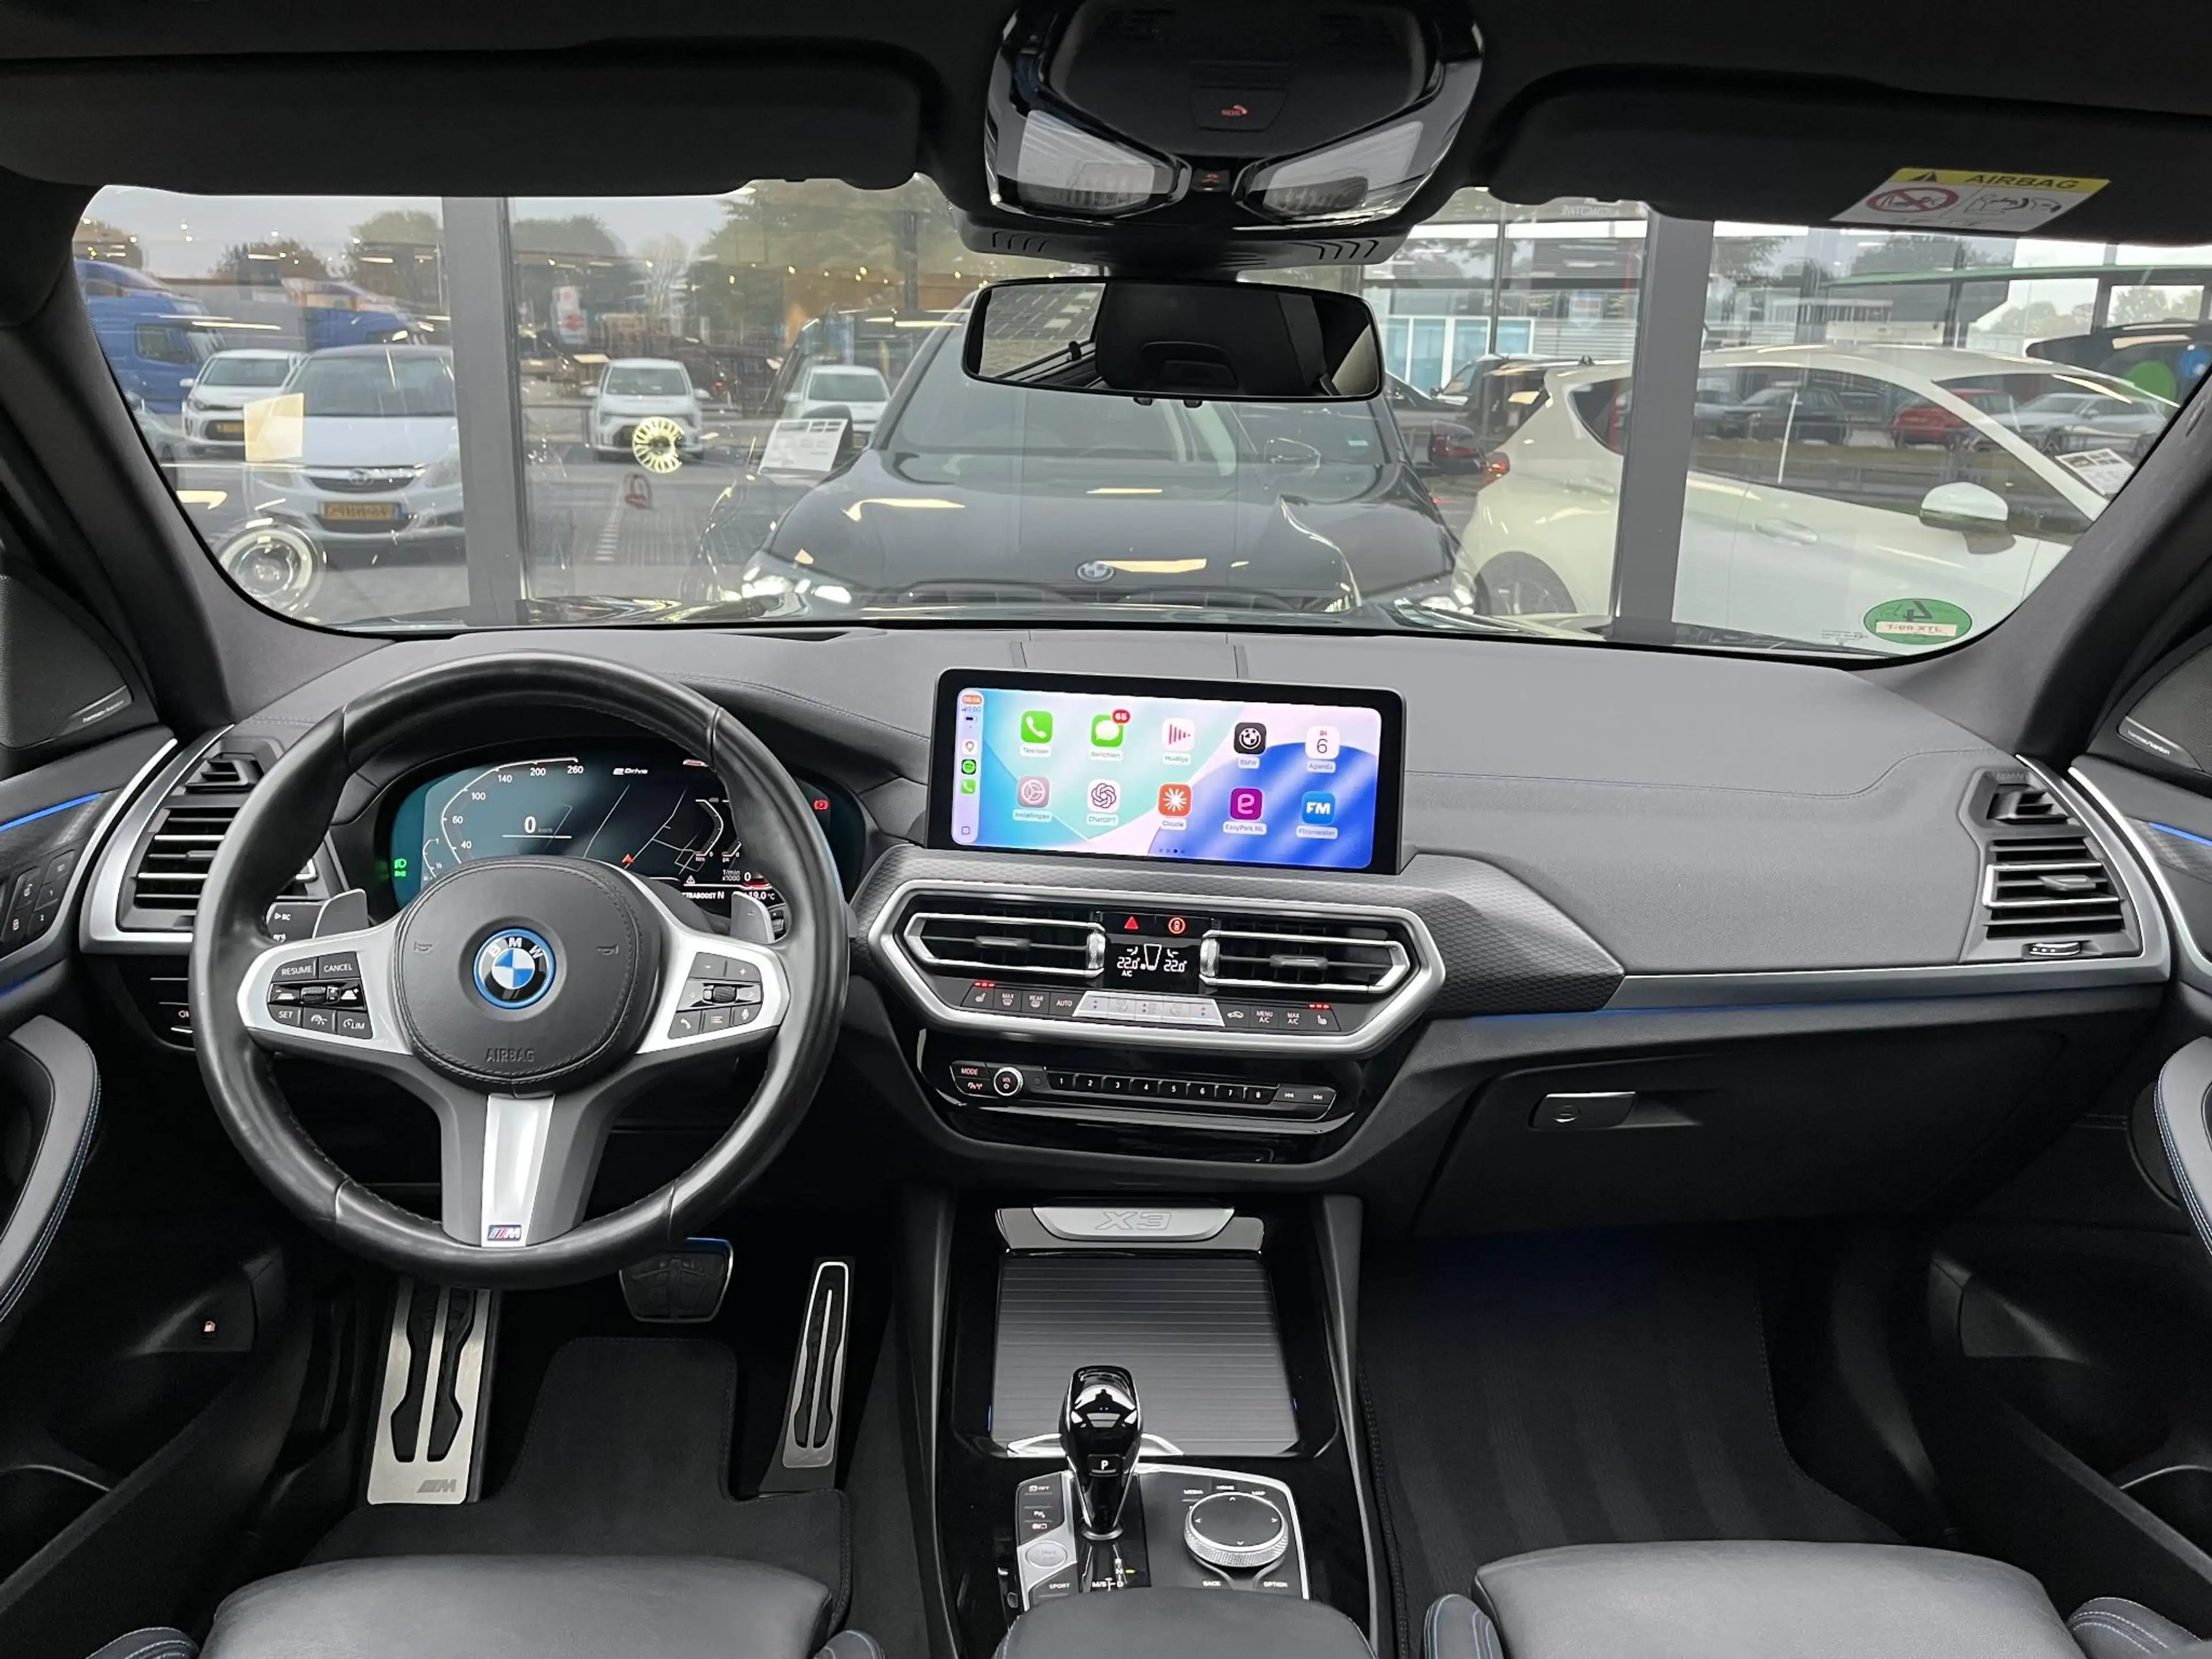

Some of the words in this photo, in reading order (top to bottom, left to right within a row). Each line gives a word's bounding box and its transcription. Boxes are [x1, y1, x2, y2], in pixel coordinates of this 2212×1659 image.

[1964, 175, 2080, 189] AIRBAG
[1316, 738, 1328, 754] 6
[1240, 759, 1257, 767] BMW
[1308, 762, 1334, 771] Agenda
[530, 767, 547, 777] 200
[567, 765, 584, 774] 260
[497, 774, 513, 783] 140
[471, 791, 486, 801] 100
[1306, 801, 1331, 815] FM
[452, 816, 463, 824] 60
[1162, 820, 1184, 828] Claude
[524, 816, 536, 834] 0
[1225, 824, 1254, 833] EasyPark
[461, 840, 472, 849] 40
[744, 872, 752, 882] 0
[717, 892, 725, 900] N
[488, 937, 543, 959] BMW
[281, 965, 312, 976] RESUME
[324, 963, 353, 973] CANCEL
[278, 1010, 293, 1019] SET
[350, 1022, 365, 1030] LIM
[485, 1047, 535, 1063] AIRBAG
[960, 1067, 979, 1076] MODE
[1094, 1211, 1172, 1230] X3
[1101, 1460, 1109, 1469] P
